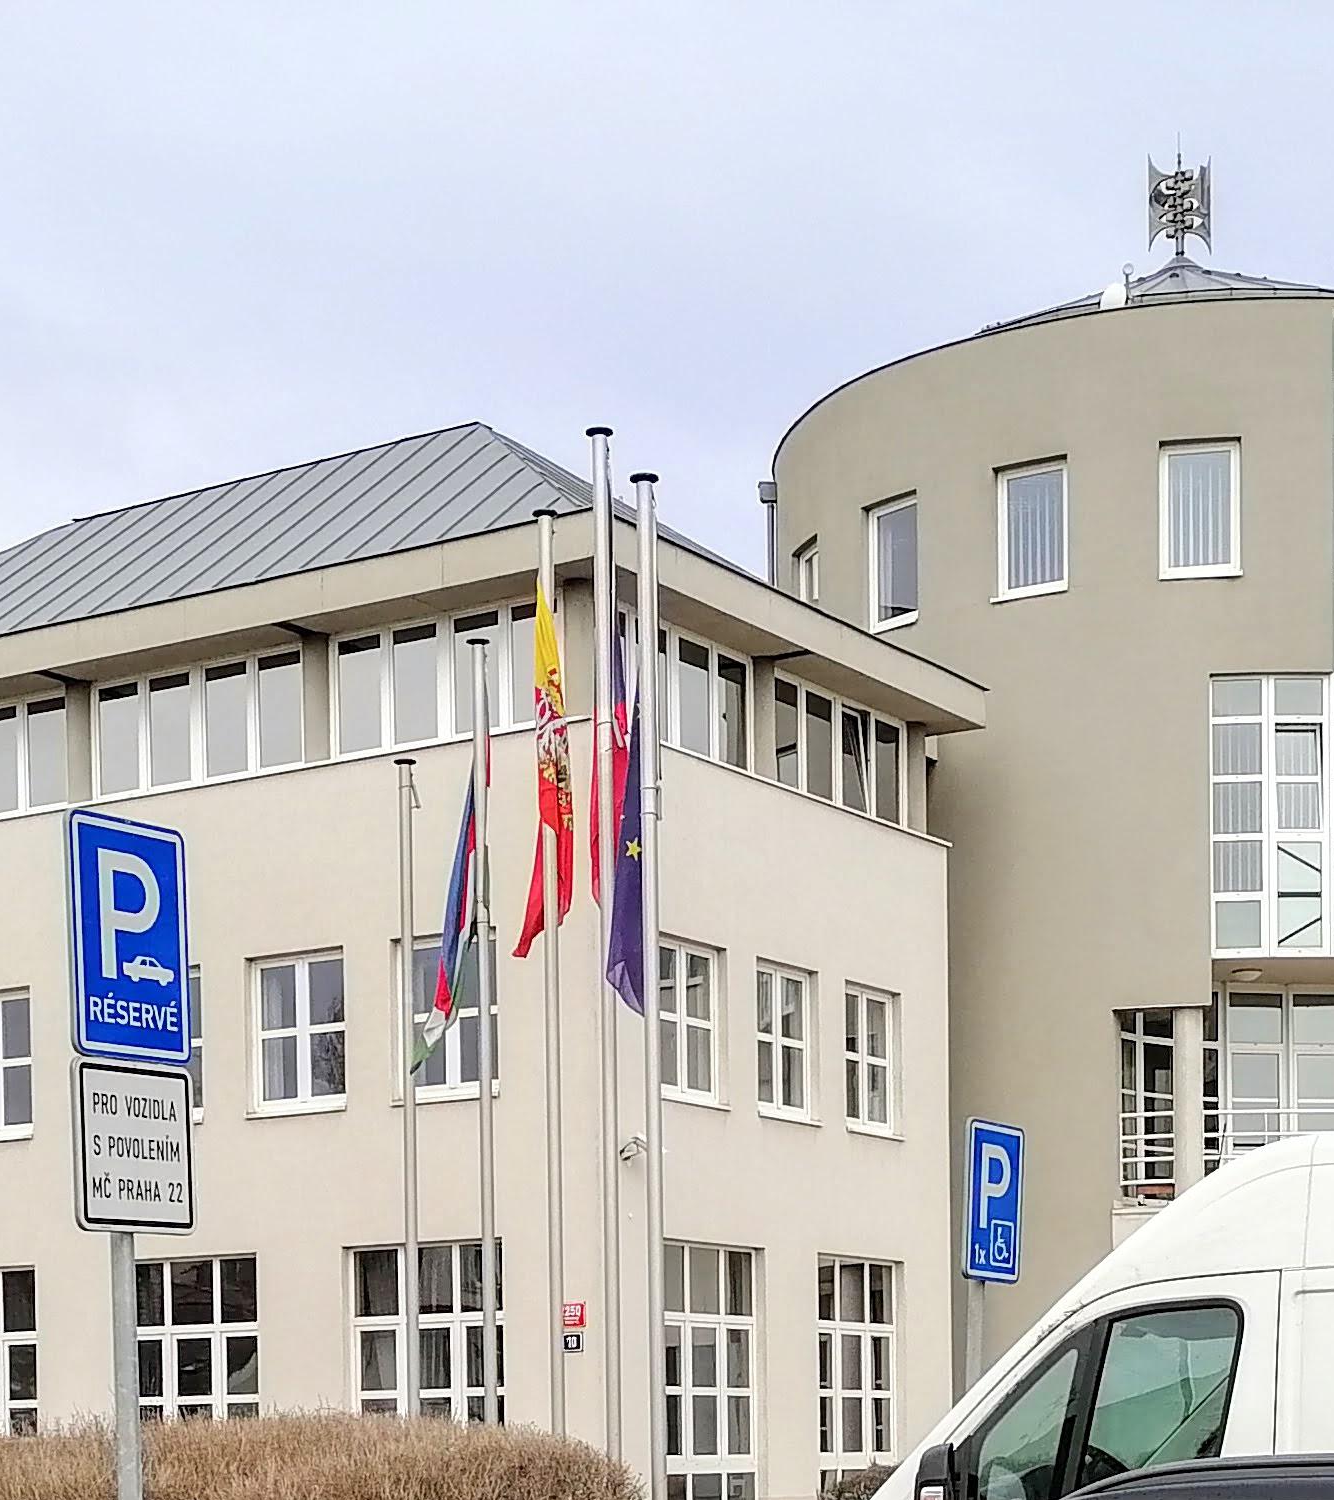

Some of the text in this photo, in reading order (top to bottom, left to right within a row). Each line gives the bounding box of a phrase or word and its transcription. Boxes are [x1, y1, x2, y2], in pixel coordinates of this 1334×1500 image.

[98, 847, 161, 980] P
[89, 991, 179, 1032] RÉSERVÉ
[92, 1092, 178, 1123] PRO VOZIDLA
[93, 1134, 181, 1163] S POVOLENÍM
[92, 1172, 184, 1204] MČ PRAHA 22
[979, 1142, 1012, 1229] P
